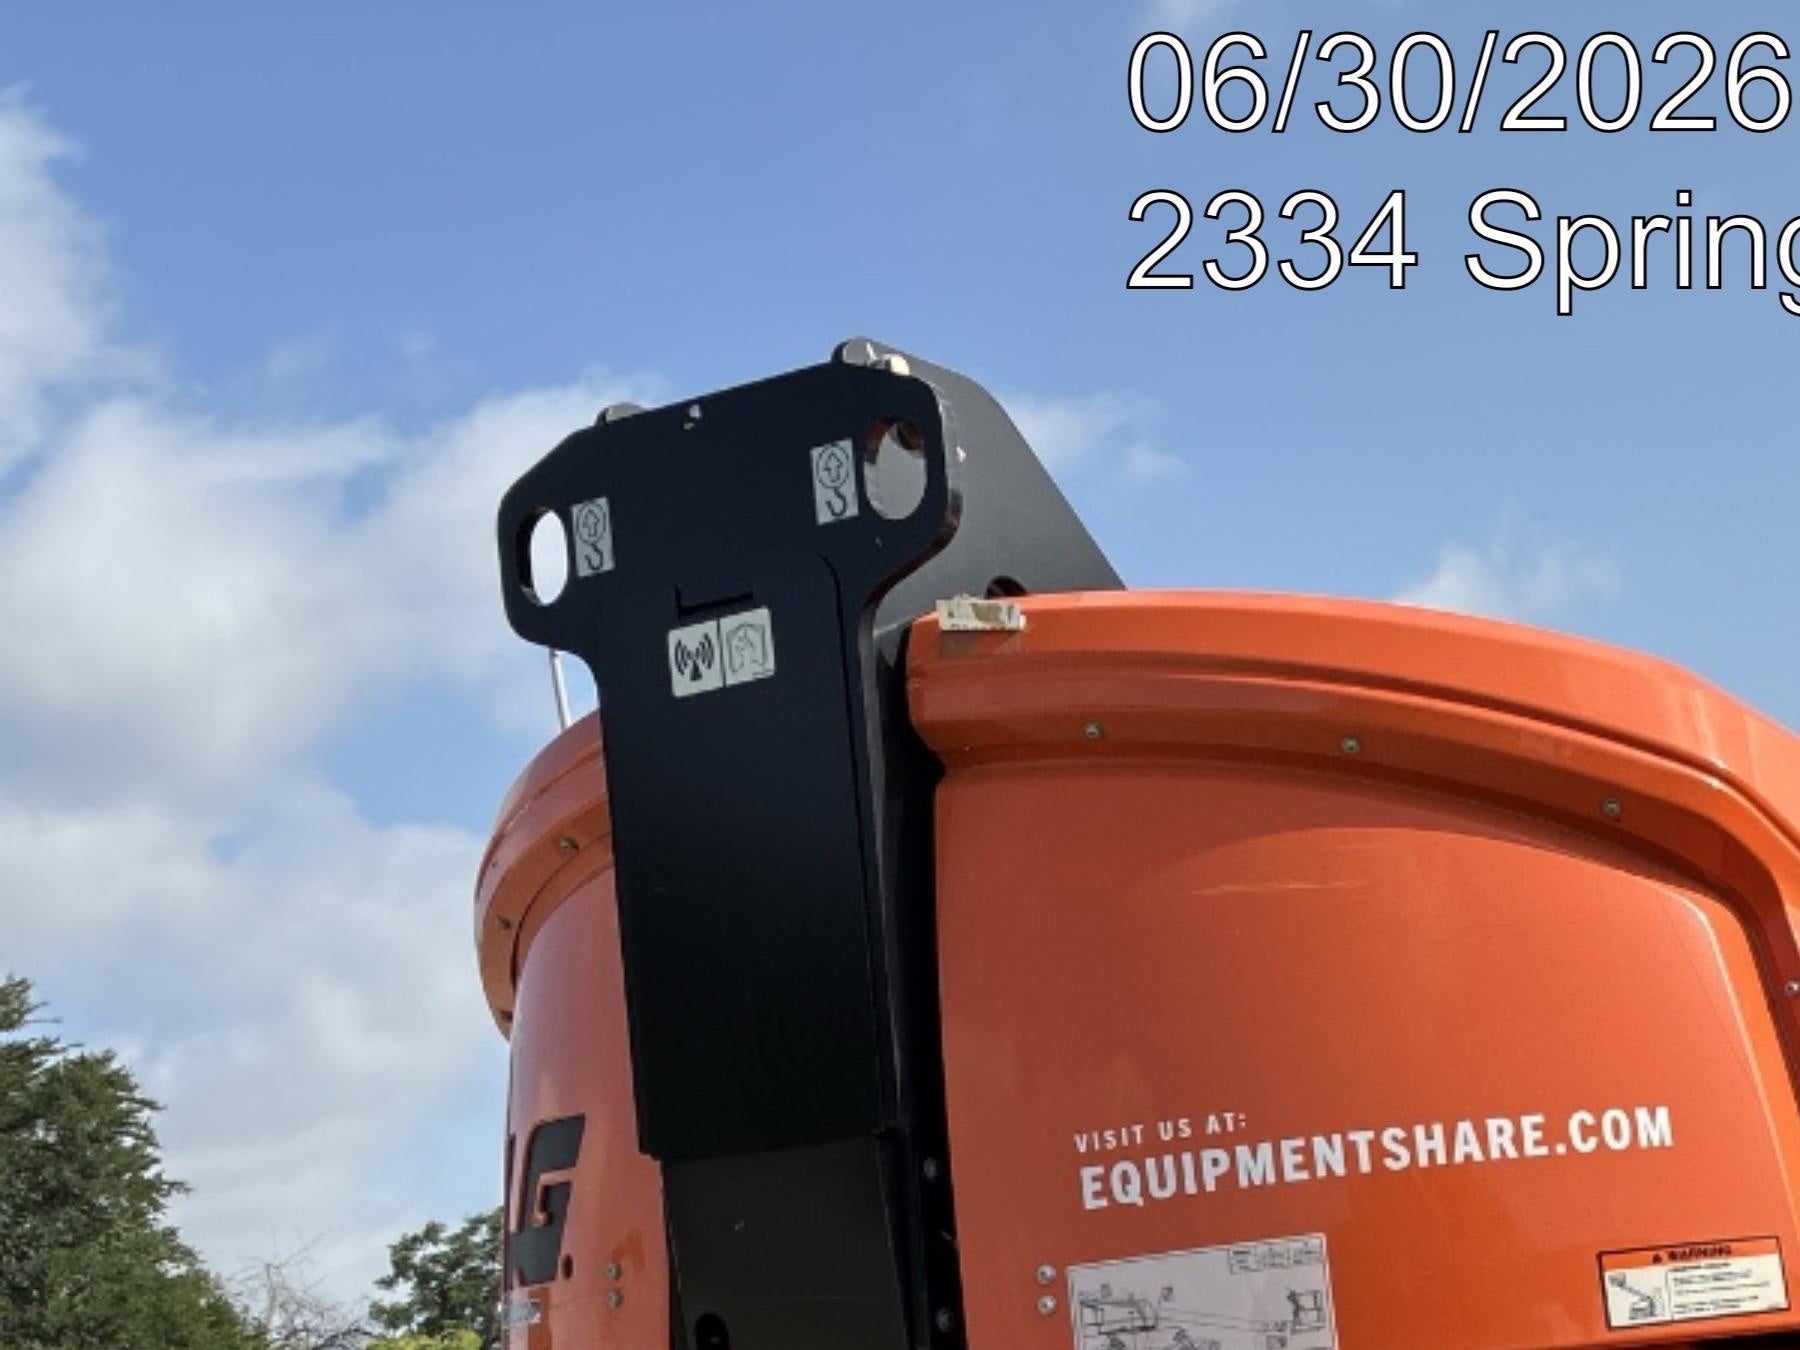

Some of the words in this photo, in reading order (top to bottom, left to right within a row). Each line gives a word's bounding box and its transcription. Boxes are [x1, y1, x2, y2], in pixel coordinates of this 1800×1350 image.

[1074, 1124, 1144, 1154] VISIT
[1160, 1115, 1194, 1142] US
[1206, 1112, 1248, 1134] AT:
[1078, 1106, 1675, 1211] EQUIPMENTSHARE.COM
